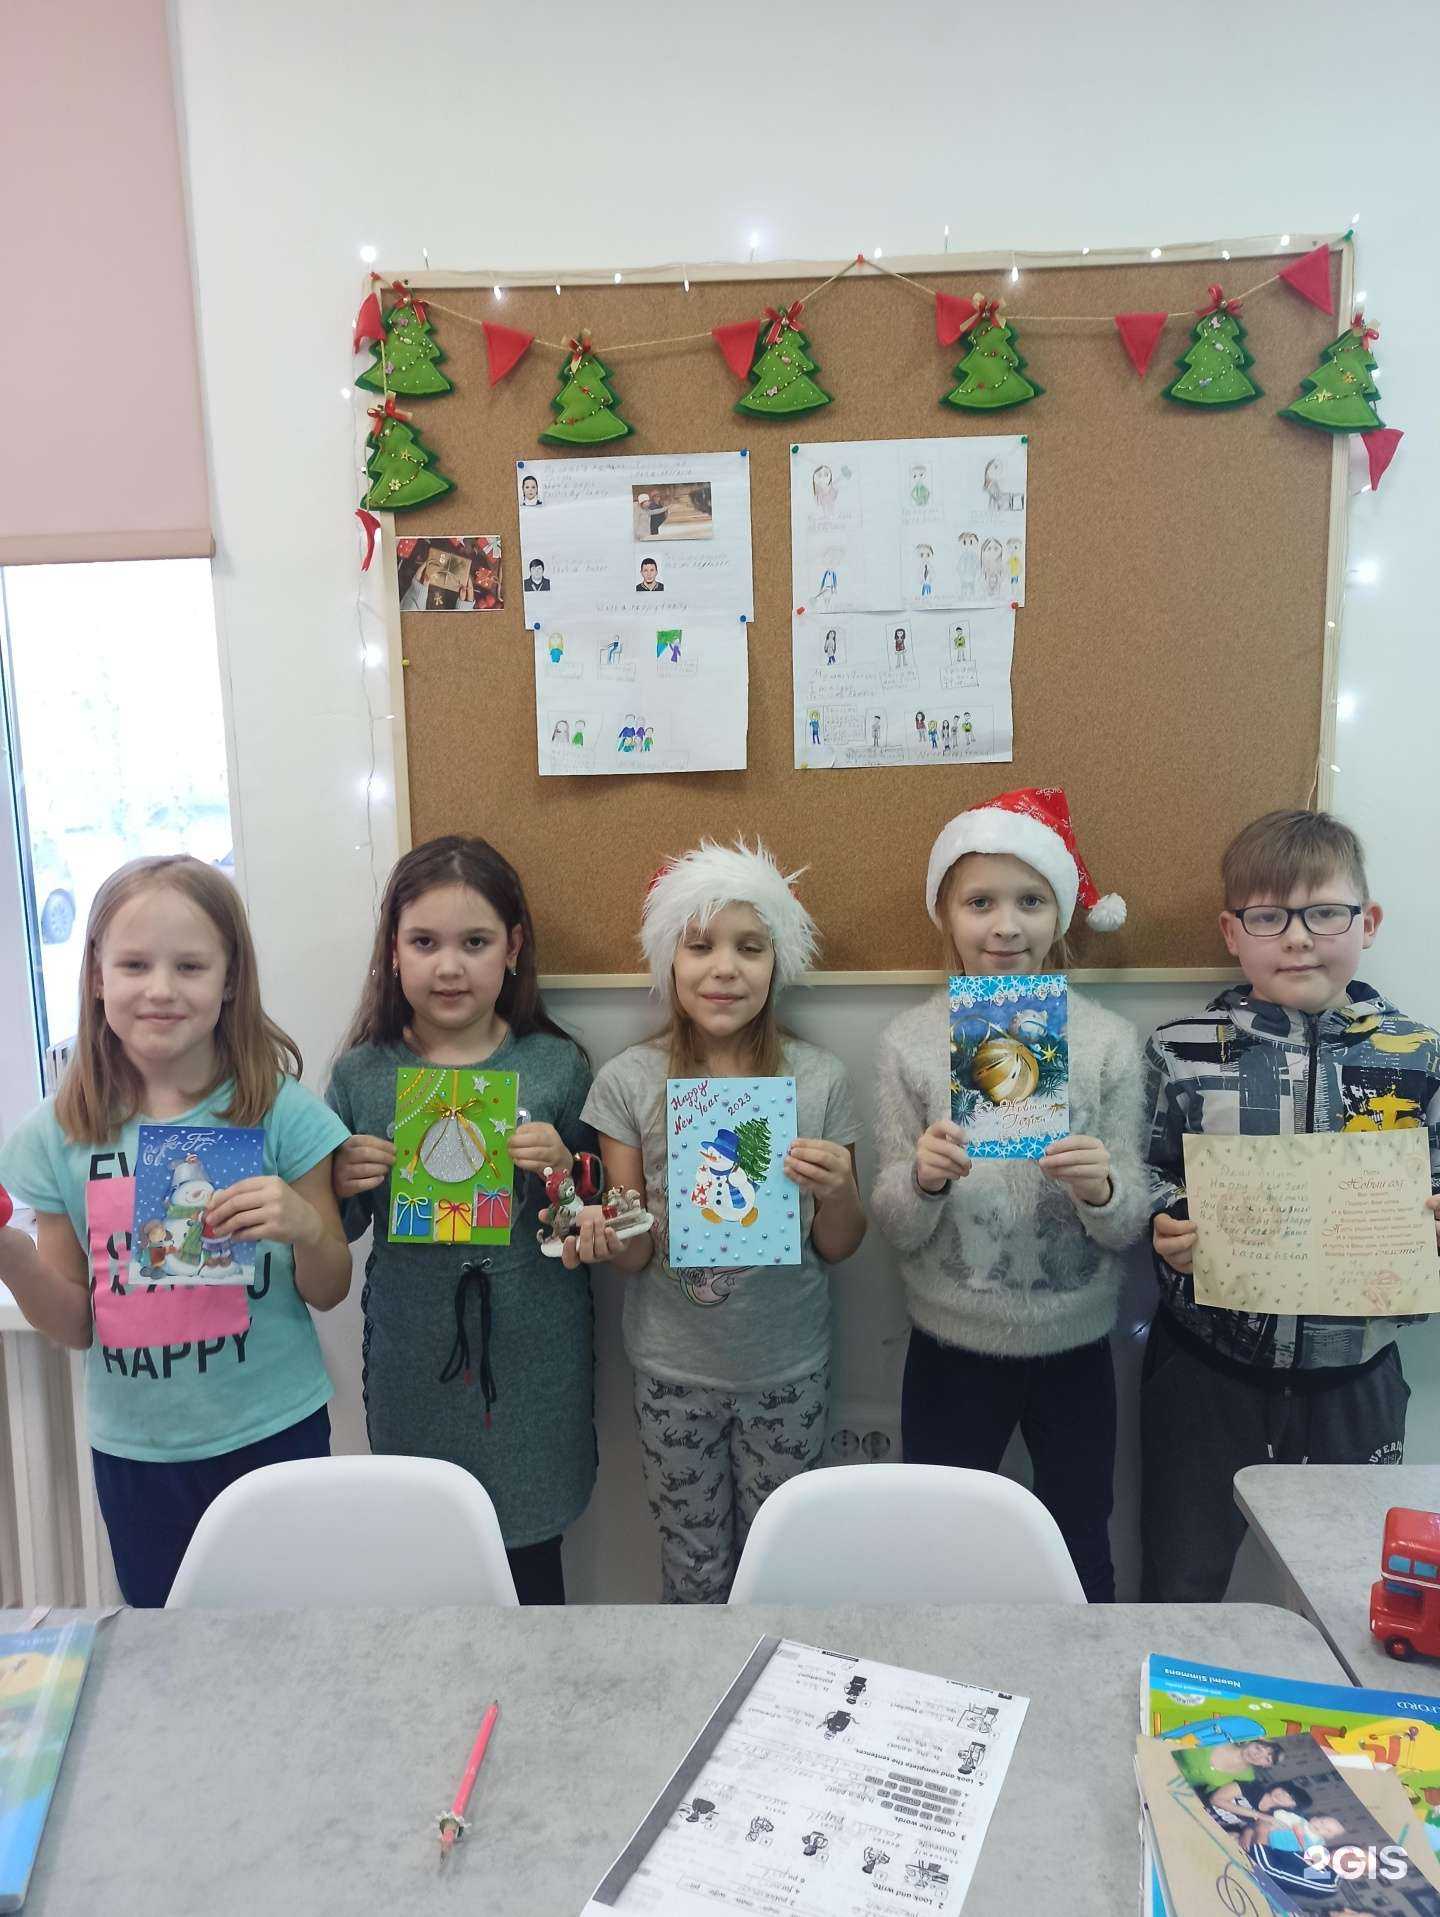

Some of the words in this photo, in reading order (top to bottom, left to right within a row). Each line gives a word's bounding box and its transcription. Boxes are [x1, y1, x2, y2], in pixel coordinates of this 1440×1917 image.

[671, 1080, 708, 1111] Happy
[674, 1114, 693, 1135] New
[727, 1092, 751, 1116] 2023
[103, 1317, 253, 1379] HAPPY
[1164, 1668, 1208, 1682] Simmons
[1208, 1676, 1242, 1689] Naomi
